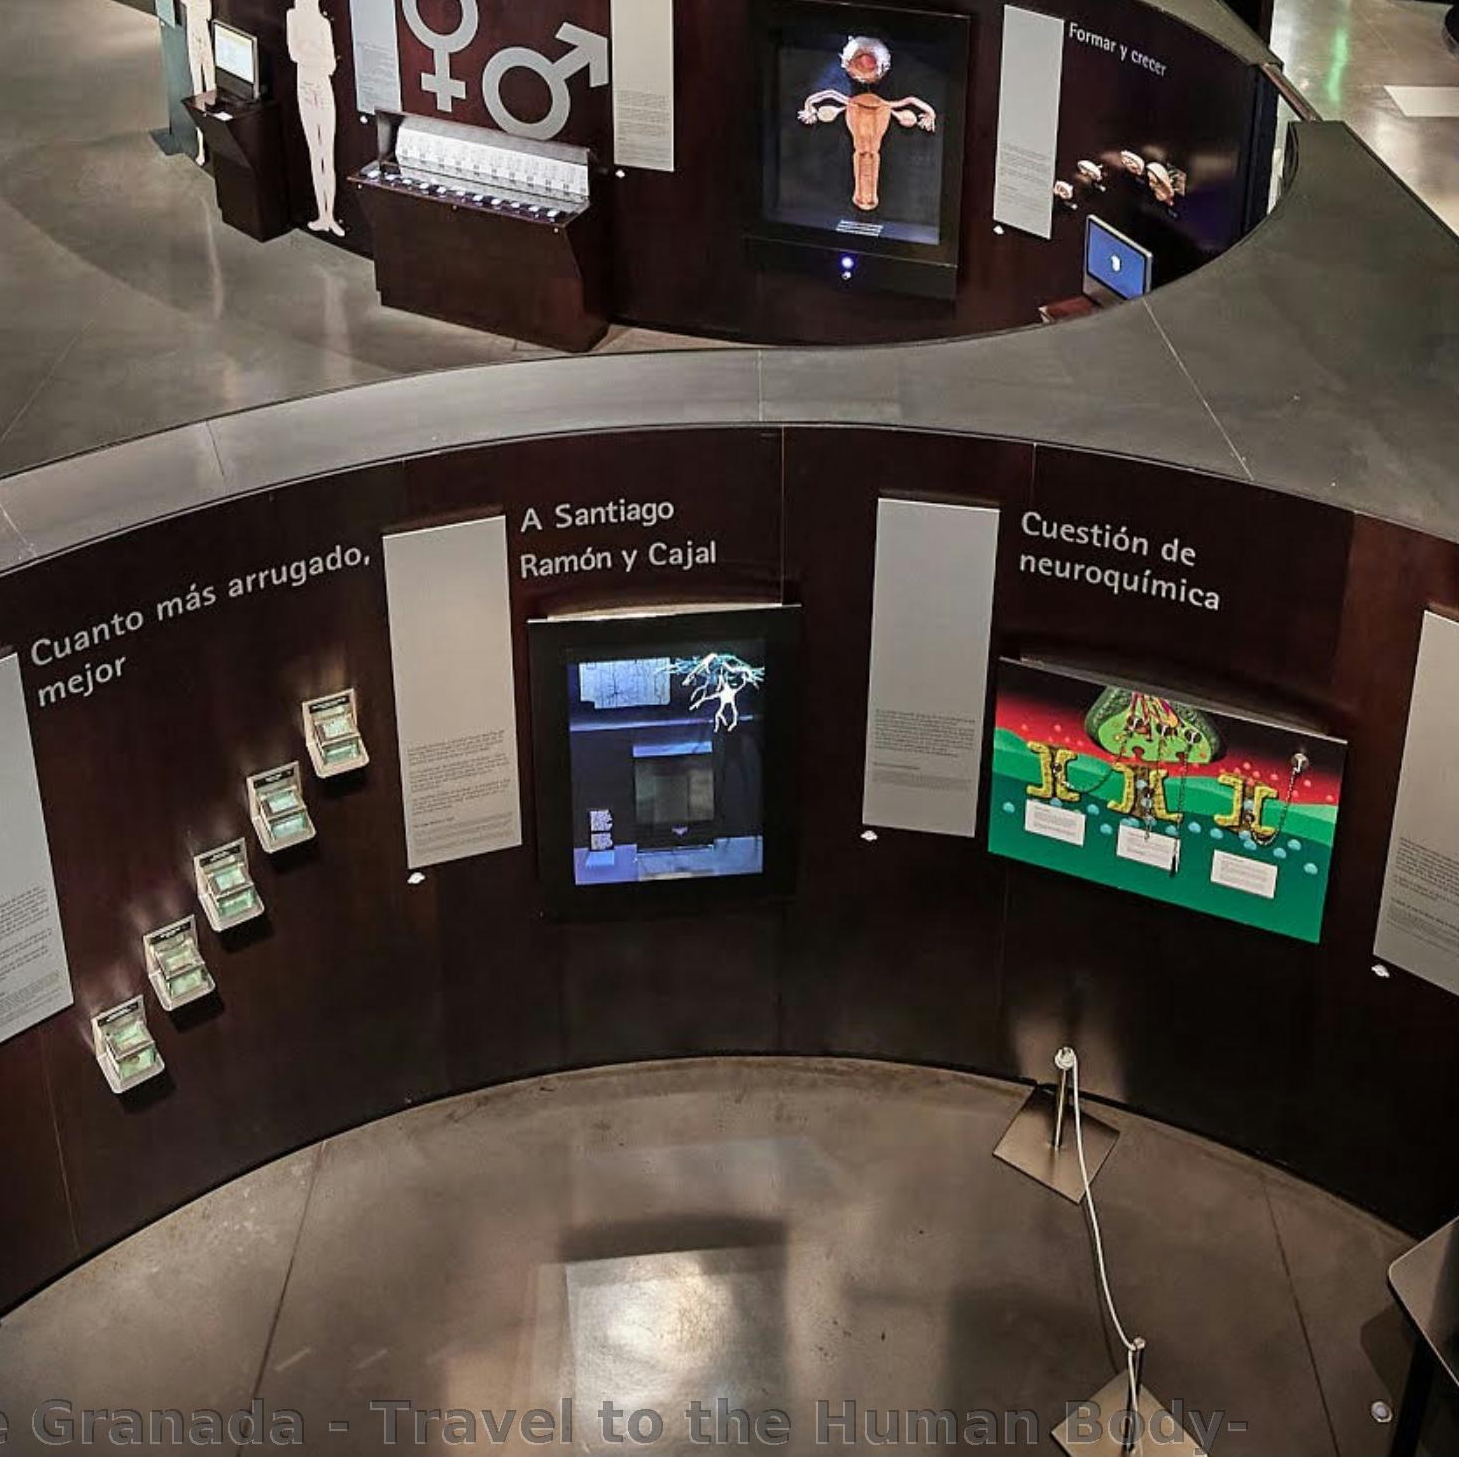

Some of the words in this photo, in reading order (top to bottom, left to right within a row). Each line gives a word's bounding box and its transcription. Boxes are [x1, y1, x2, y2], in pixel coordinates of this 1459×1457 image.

[1069, 22, 1117, 53] Formar
[1119, 44, 1128, 62] y
[1131, 50, 1167, 77] crecer
[520, 507, 543, 533] A
[555, 498, 675, 529] Santiago
[1021, 510, 1148, 556] Cuestión
[1161, 537, 1197, 567] de
[520, 546, 612, 579] Ramón
[621, 548, 638, 573] y
[648, 540, 716, 571] Cajal
[1019, 553, 1220, 612] neuroquímica
[30, 610, 144, 666] Cuanto
[156, 583, 218, 621] más
[228, 544, 371, 598] arrugado,
[38, 655, 127, 707] mejor
